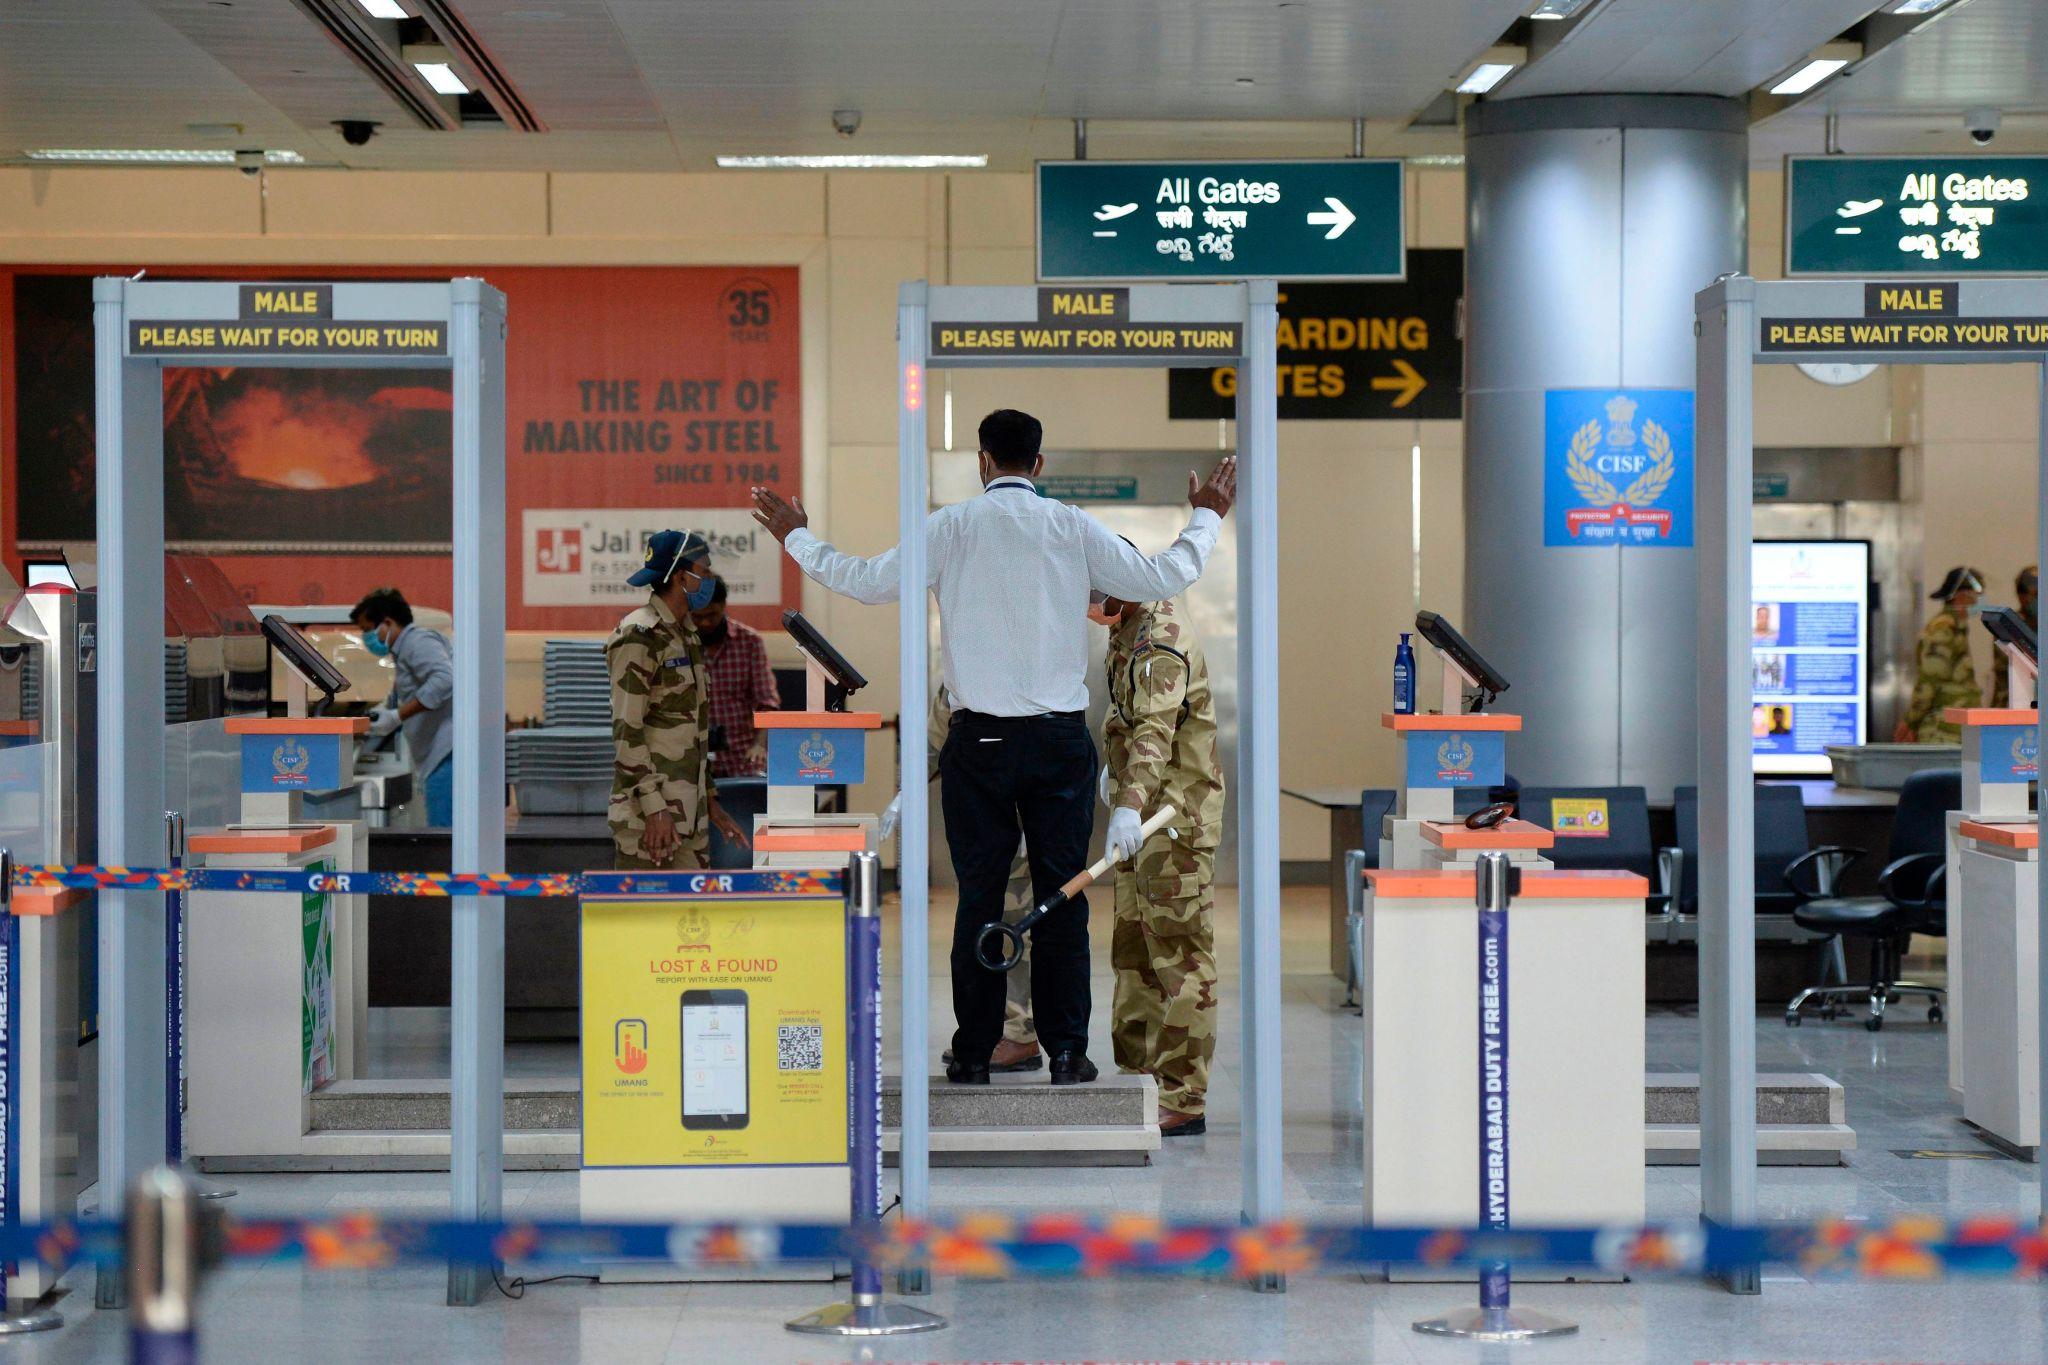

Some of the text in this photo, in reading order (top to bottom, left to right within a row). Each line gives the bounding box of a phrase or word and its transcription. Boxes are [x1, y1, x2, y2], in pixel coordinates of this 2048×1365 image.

[1155, 177, 1281, 204] All Gates
[1899, 173, 2029, 201] All Gates
[1155, 205, 1248, 233] सभी गेट्स
[255, 291, 318, 313] MALE
[728, 290, 771, 327] 35
[1053, 294, 1114, 315] MALE
[1880, 289, 1943, 310] MALE
[139, 327, 439, 348] PLEASE WAIT FOR YOUR TURN
[941, 330, 1234, 348] PLEASE WAIT FOR YOUR TURN
[1276, 317, 1429, 351] ARDING
[1770, 324, 2048, 344] PLEASE WAIT FOR YOUR TUR
[1211, 363, 1346, 398] GTES
[578, 379, 780, 413] THE ART OF
[523, 420, 781, 454] MAKING STEEL
[654, 463, 780, 484] SINCE 1984
[1597, 454, 1647, 473] CISF
[590, 529, 630, 553] Jai
[308, 873, 351, 893] GMR
[690, 874, 733, 893] GMR
[650, 958, 778, 974] LOST & FOUND
[656, 976, 687, 984] REPORT
[688, 976, 708, 984] WITH
[709, 976, 729, 984] EASE
[743, 975, 773, 983] UMANG
[1483, 937, 1500, 1034] FREE.com
[1485, 1040, 1502, 1093] DUTY
[614, 1079, 649, 1087] UMANG
